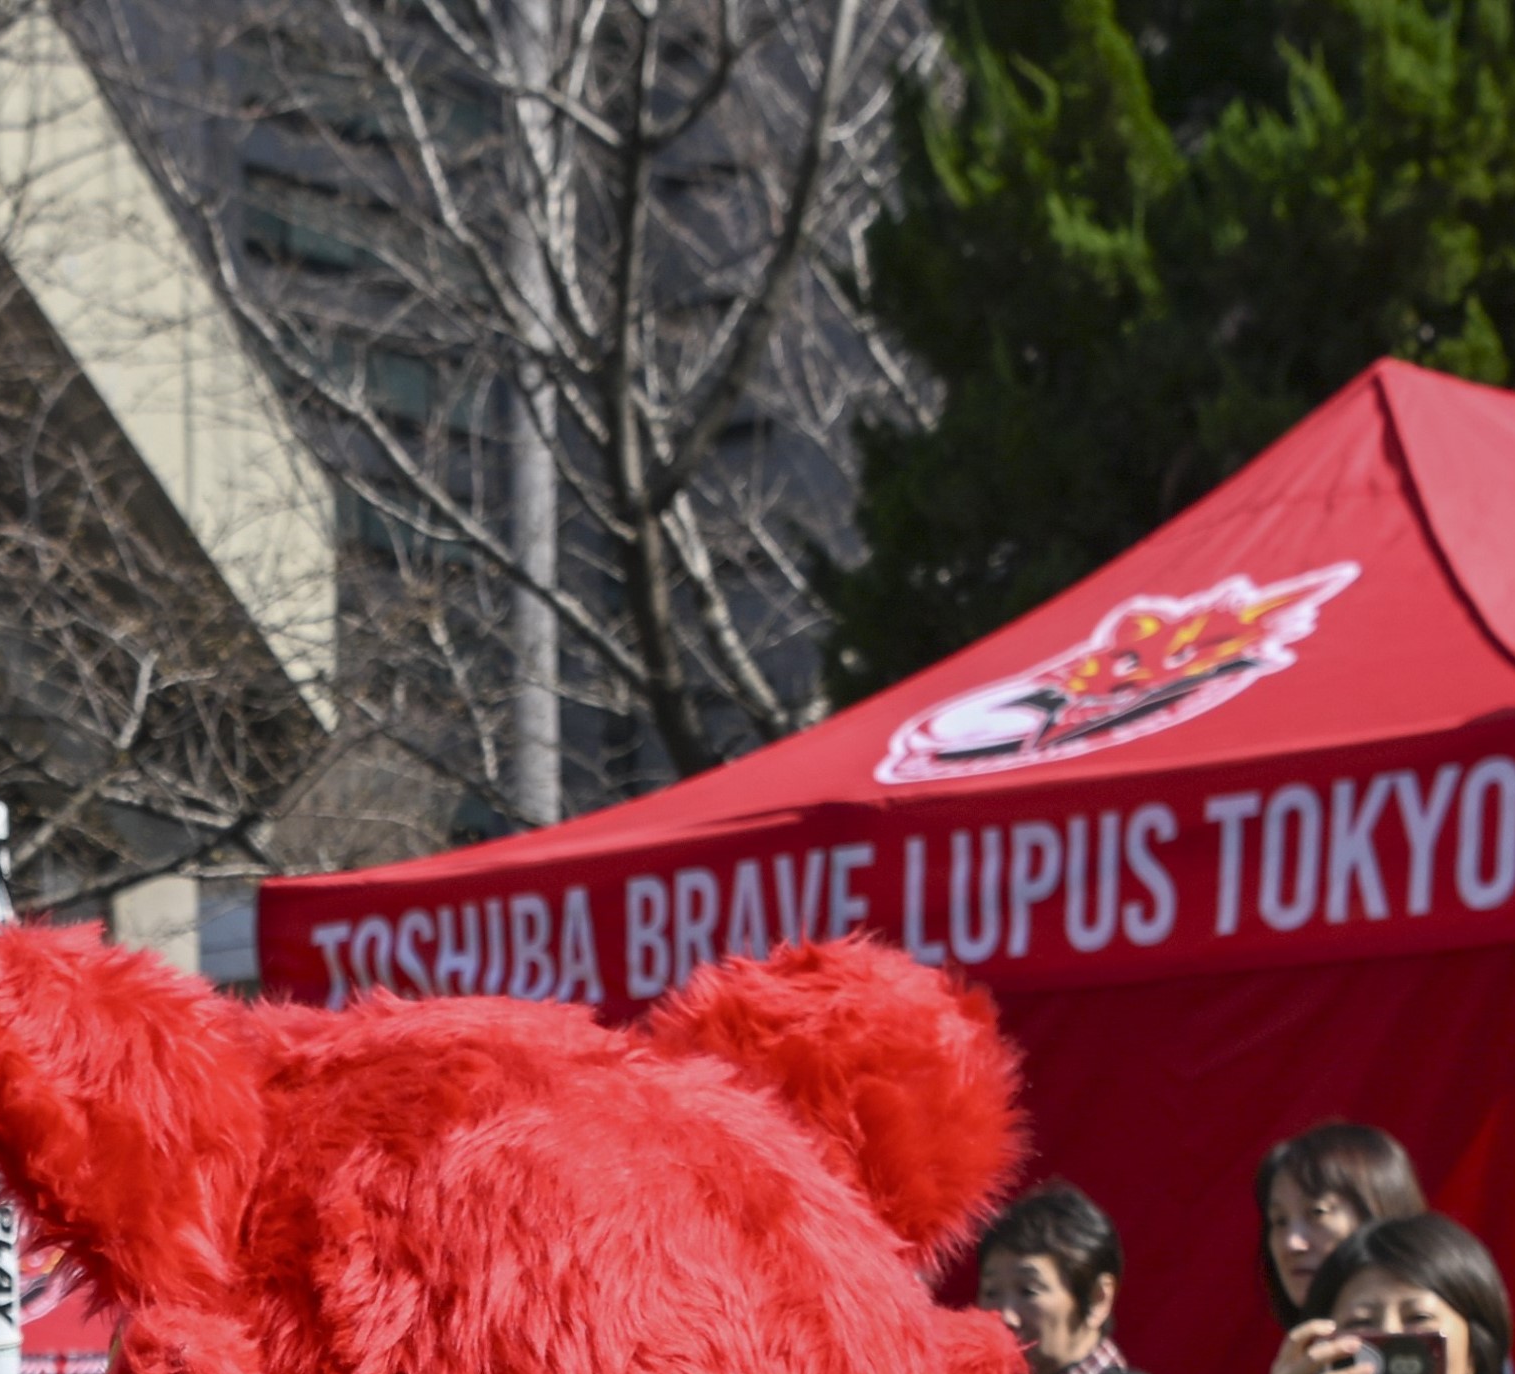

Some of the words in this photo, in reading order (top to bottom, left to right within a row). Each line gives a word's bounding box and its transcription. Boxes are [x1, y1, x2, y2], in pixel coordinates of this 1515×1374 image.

[311, 887, 604, 1012] TOSHIBA
[625, 843, 875, 999] BRAVE
[903, 808, 1177, 967] LUPUS
